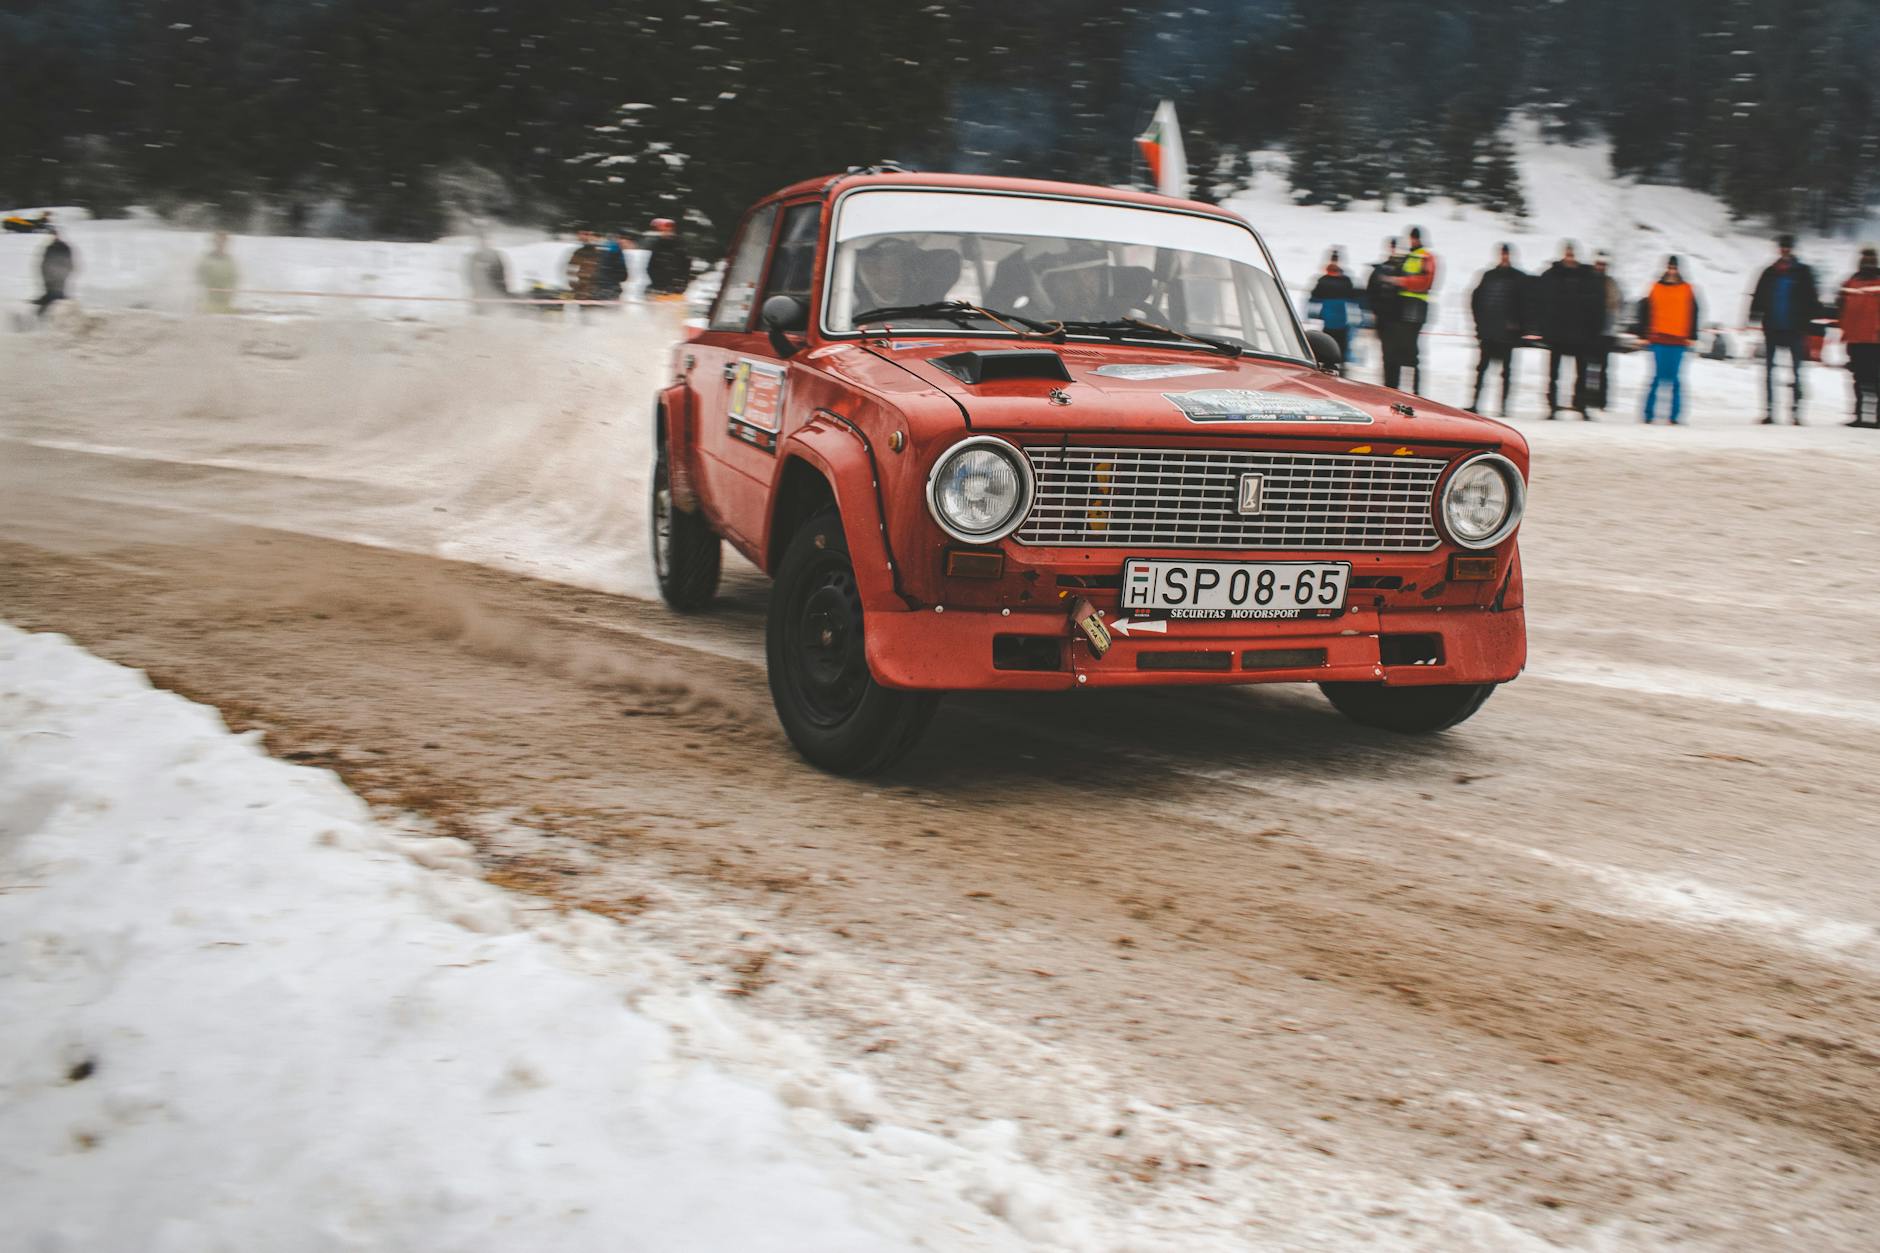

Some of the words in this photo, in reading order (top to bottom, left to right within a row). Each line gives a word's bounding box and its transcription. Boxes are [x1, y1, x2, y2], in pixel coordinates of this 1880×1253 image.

[1131, 587, 1148, 604] H
[1170, 609, 1226, 618] SECURITAS
[1231, 609, 1300, 618] MOTORSPORT
